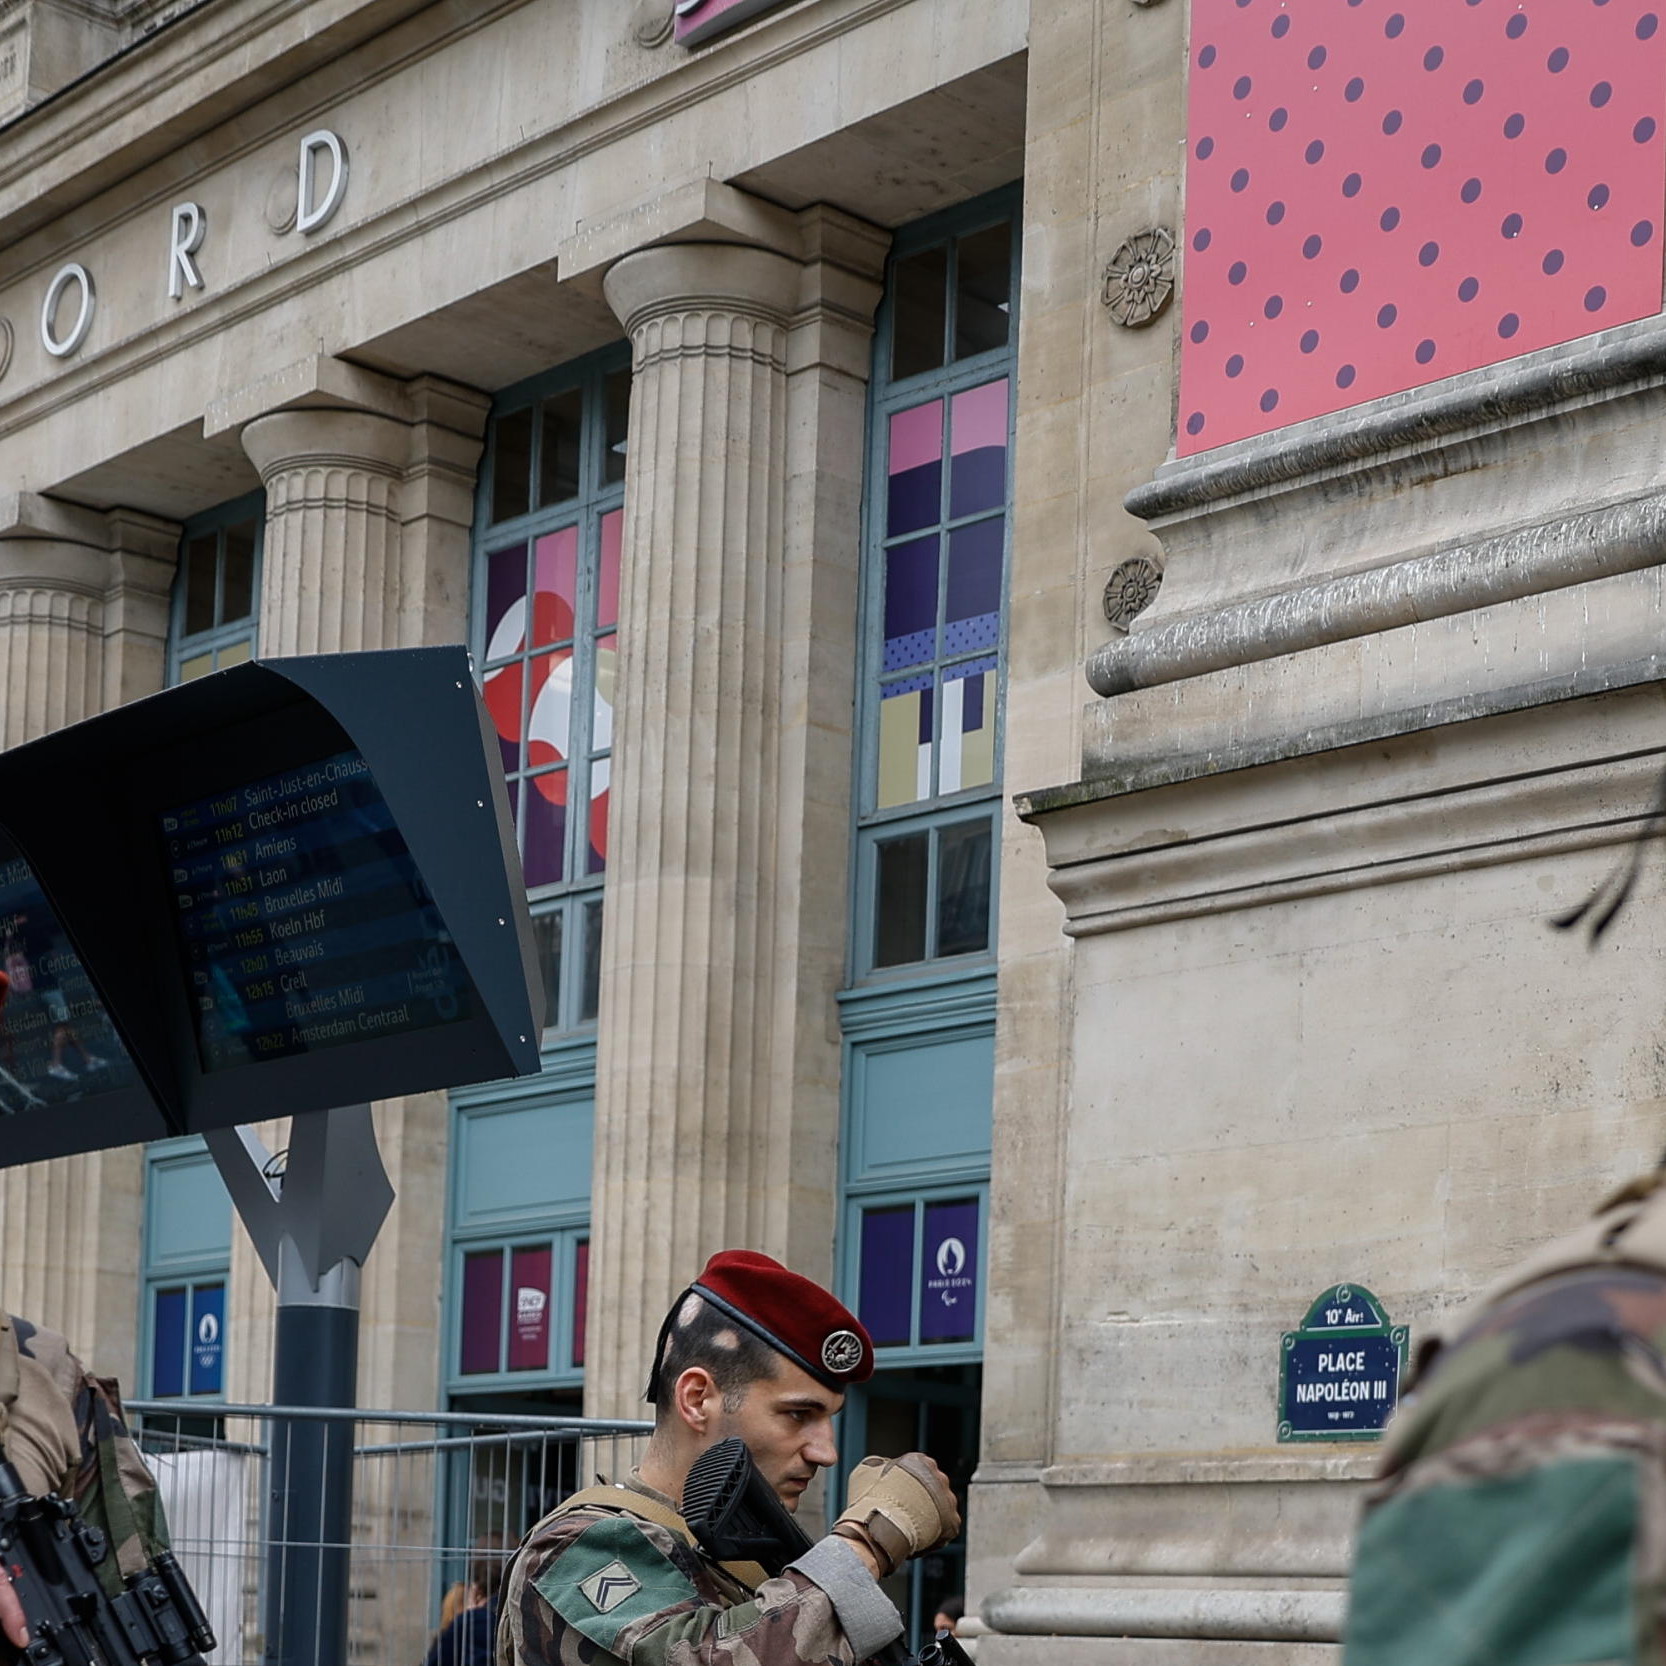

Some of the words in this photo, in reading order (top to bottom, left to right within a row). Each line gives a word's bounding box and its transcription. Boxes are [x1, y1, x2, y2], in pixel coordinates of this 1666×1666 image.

[214, 822, 245, 843] 11h12
[249, 804, 299, 830] Check-in
[300, 787, 339, 812] closed
[255, 836, 298, 860] Amiens
[225, 876, 253, 896] 11h31
[259, 868, 287, 888] Laon
[264, 886, 317, 914] Bruxelles
[317, 876, 344, 899] Midi
[269, 919, 302, 940] Koeln
[303, 909, 326, 931] Hbf
[275, 942, 324, 968] Beauvais
[280, 970, 308, 995] Creil
[285, 993, 338, 1019] Bruxelles
[338, 985, 366, 1007] Midi
[291, 1017, 356, 1045] Amsterdam
[359, 1005, 410, 1030] Centraal
[1318, 1351, 1365, 1373] PLACE
[1296, 1379, 1369, 1403] NAPOLÉON
[1373, 1380, 1387, 1400] III
